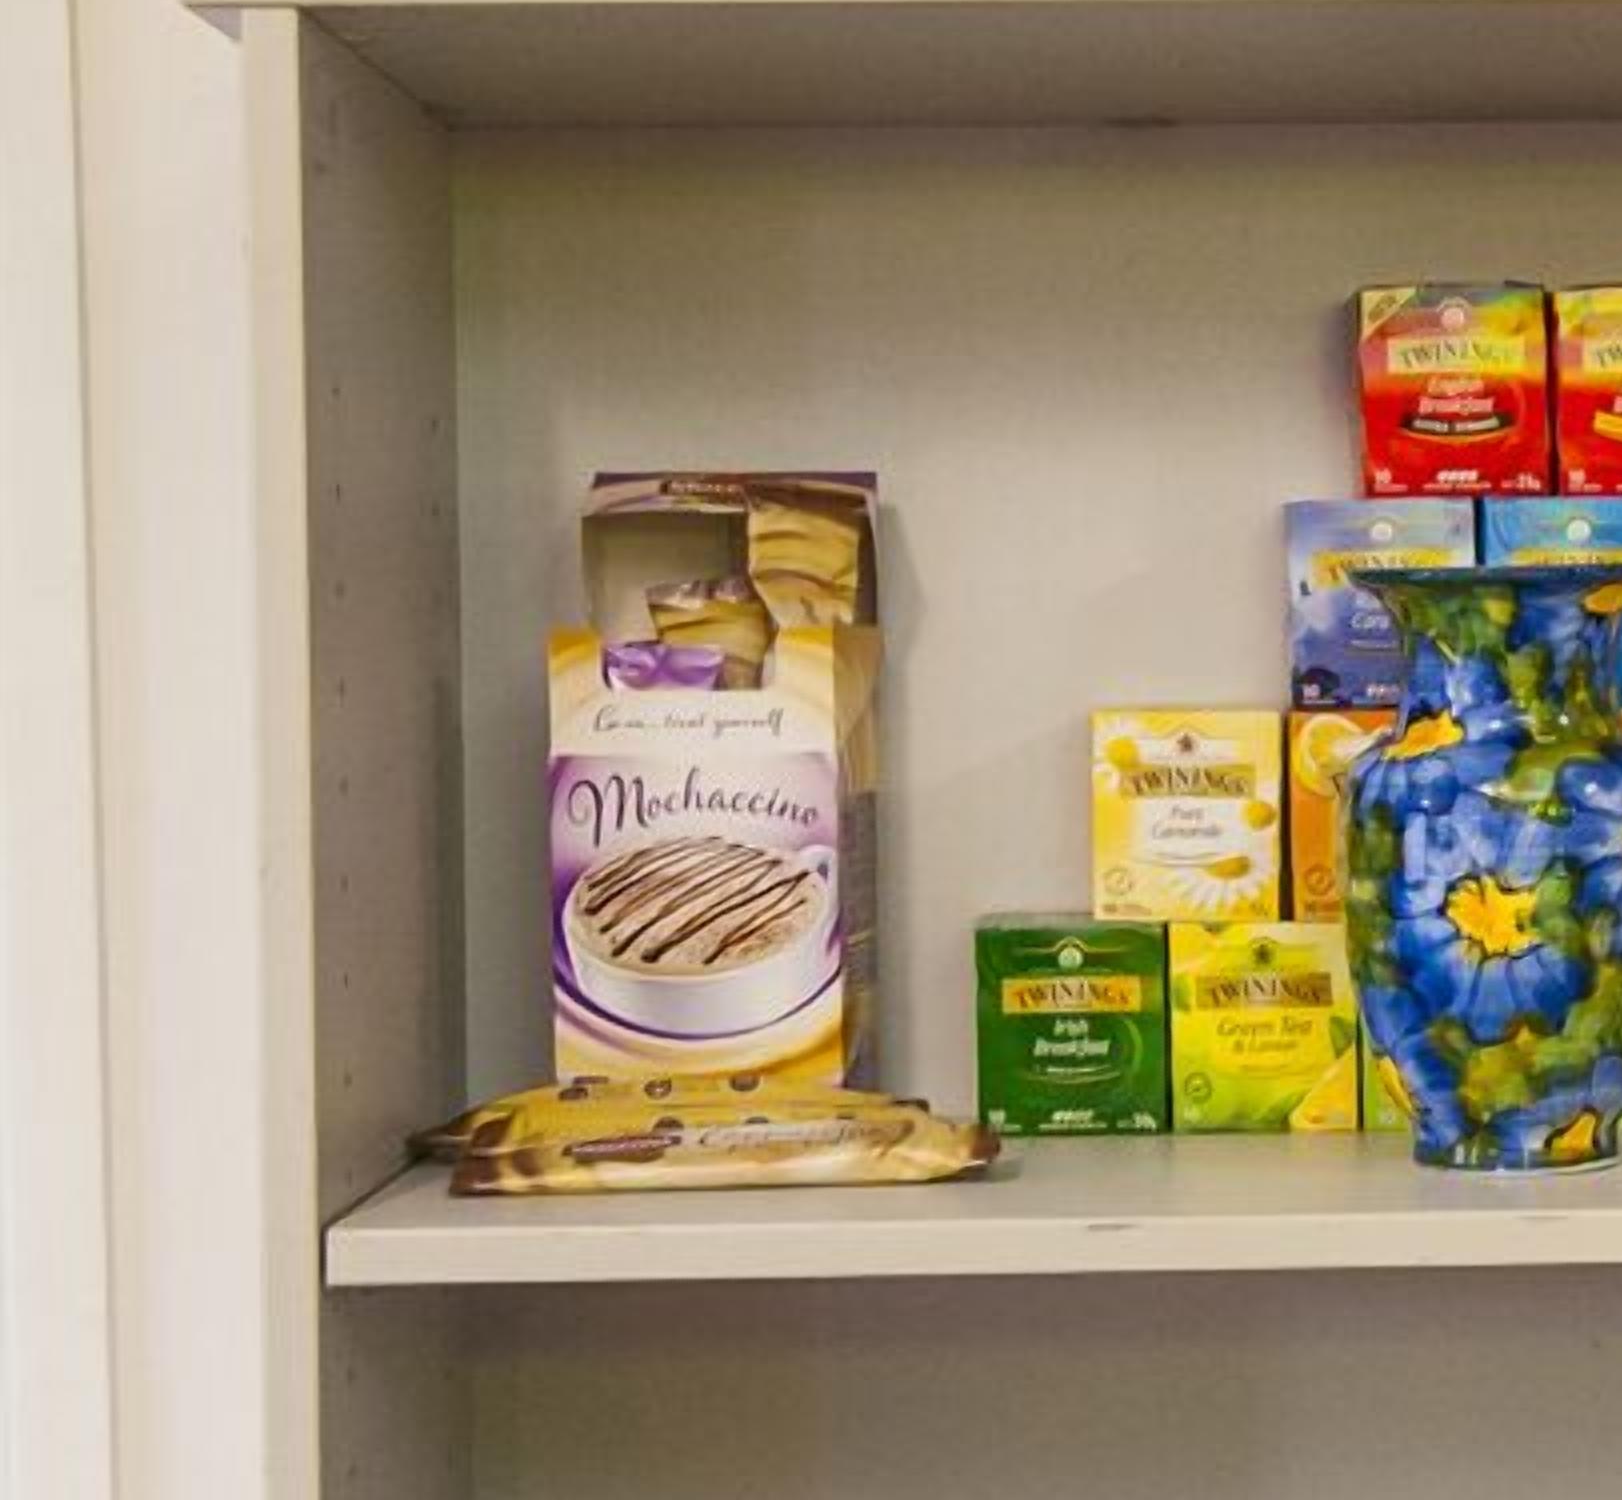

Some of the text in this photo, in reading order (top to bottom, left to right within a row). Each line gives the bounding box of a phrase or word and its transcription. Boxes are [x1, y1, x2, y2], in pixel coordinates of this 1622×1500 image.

[568, 764, 818, 848] Mochaccino
[1016, 977, 1131, 1009] TWININGS
[1210, 974, 1323, 1008] TWININGS
